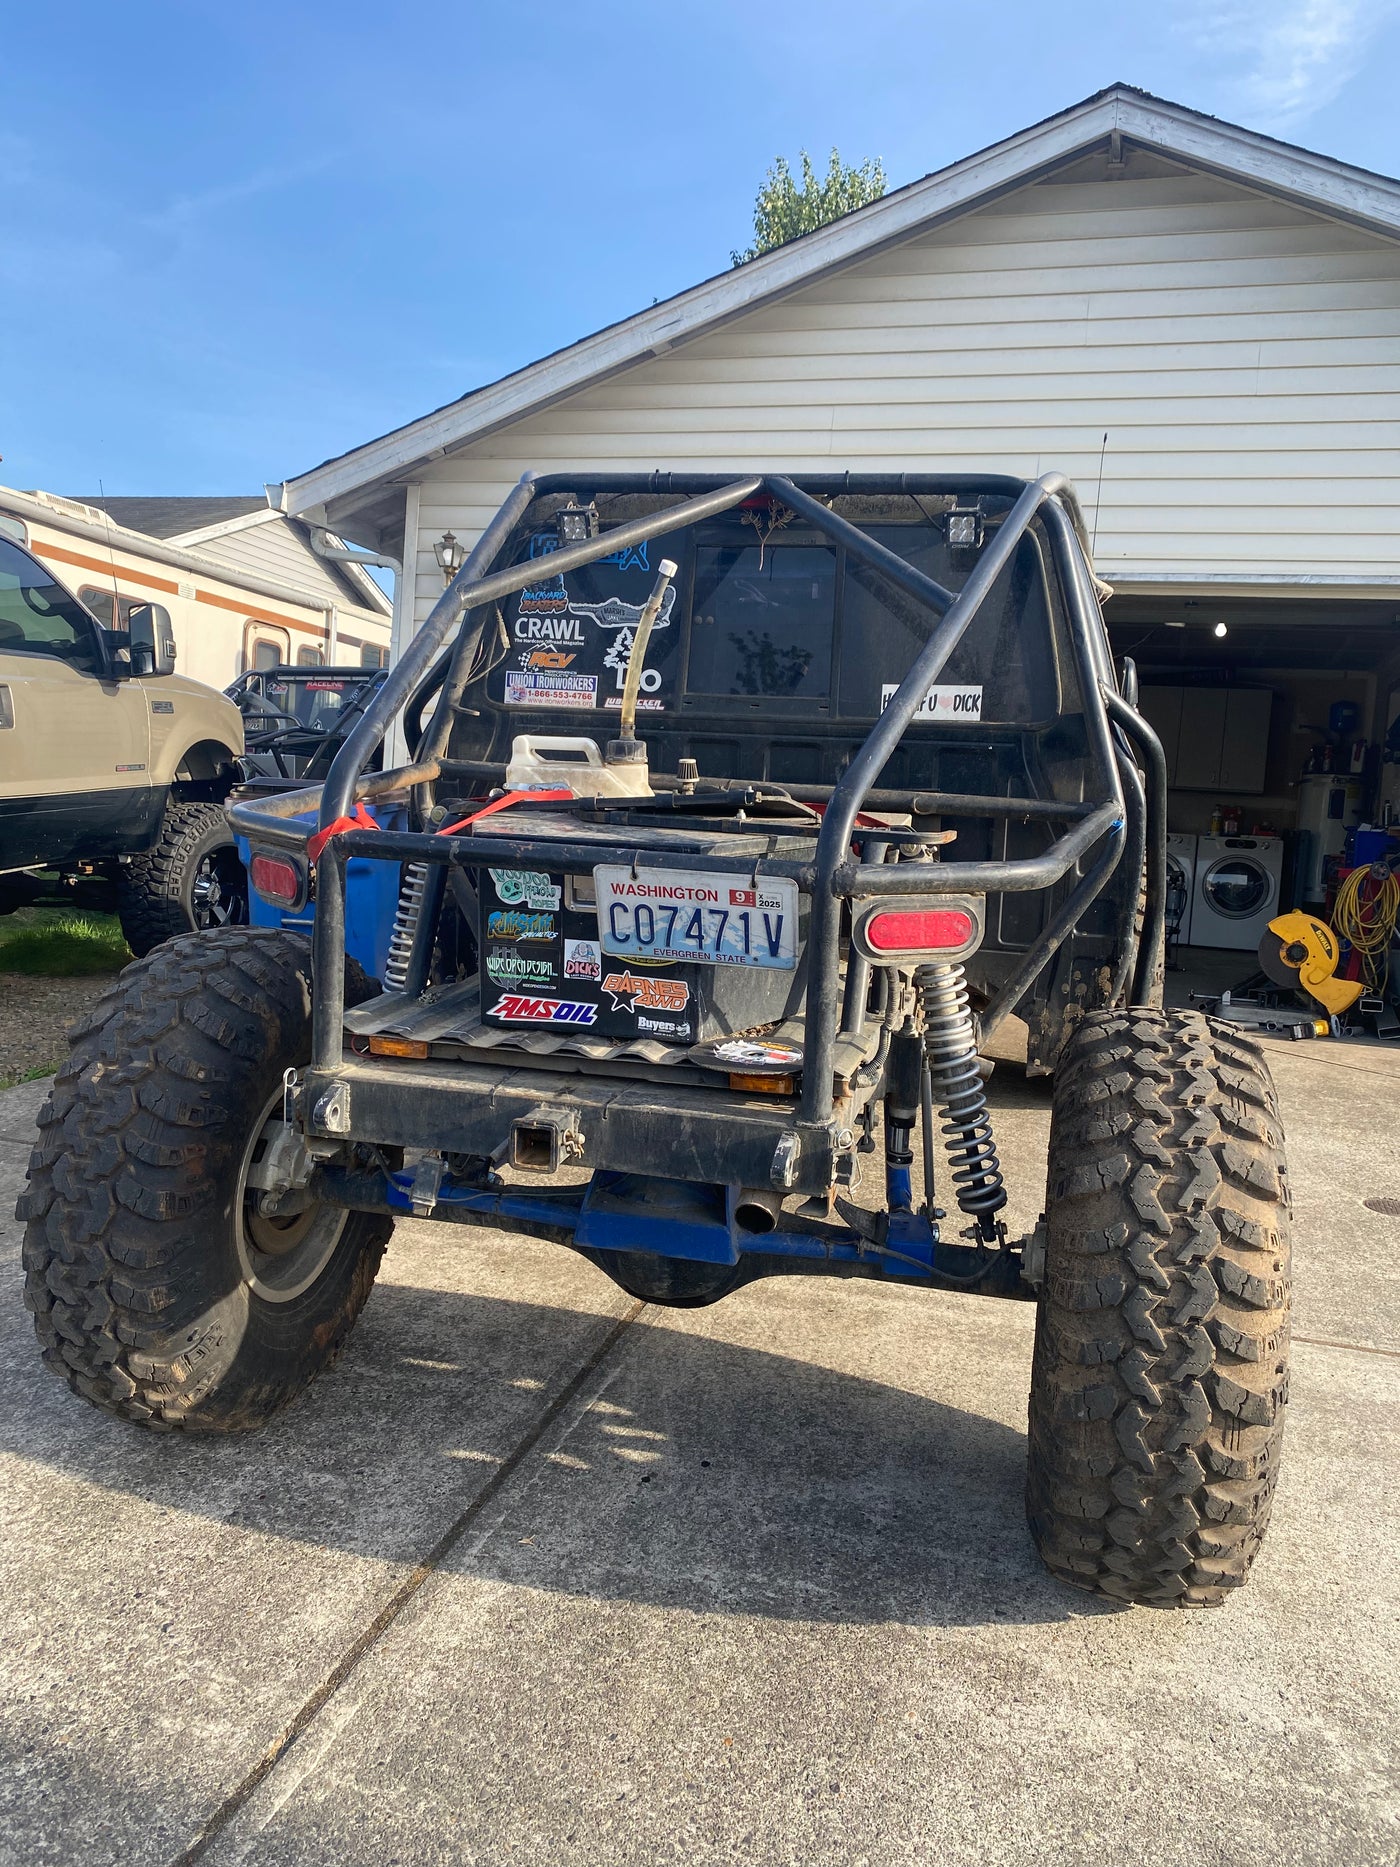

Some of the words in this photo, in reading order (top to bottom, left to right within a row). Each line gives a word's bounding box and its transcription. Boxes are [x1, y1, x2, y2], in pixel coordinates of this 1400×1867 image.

[514, 617, 585, 641] CRAWL
[528, 652, 577, 668] RCV
[509, 673, 535, 688] UNION
[536, 675, 594, 691] IRONWORKERS
[528, 690, 593, 700] 1-866-553-4766
[528, 698, 593, 707] www.ironworkers.org
[953, 694, 981, 712] DICK
[610, 883, 719, 902] WASHINGTON
[735, 891, 746, 903] 9
[531, 899, 556, 908] ROPES
[758, 900, 781, 908] 2025
[609, 902, 784, 957] C07471V
[653, 948, 711, 960] EVERGREEN
[715, 953, 746, 963] STATE
[486, 957, 505, 971] WIDE
[506, 958, 526, 973] OPEN
[527, 960, 553, 976] DESIGN
[565, 960, 600, 977] DICK'S
[603, 975, 689, 998] BARNES
[493, 996, 594, 1023] AMSOIL
[634, 993, 686, 1010] 4WD
[637, 1017, 676, 1031] Buyers
